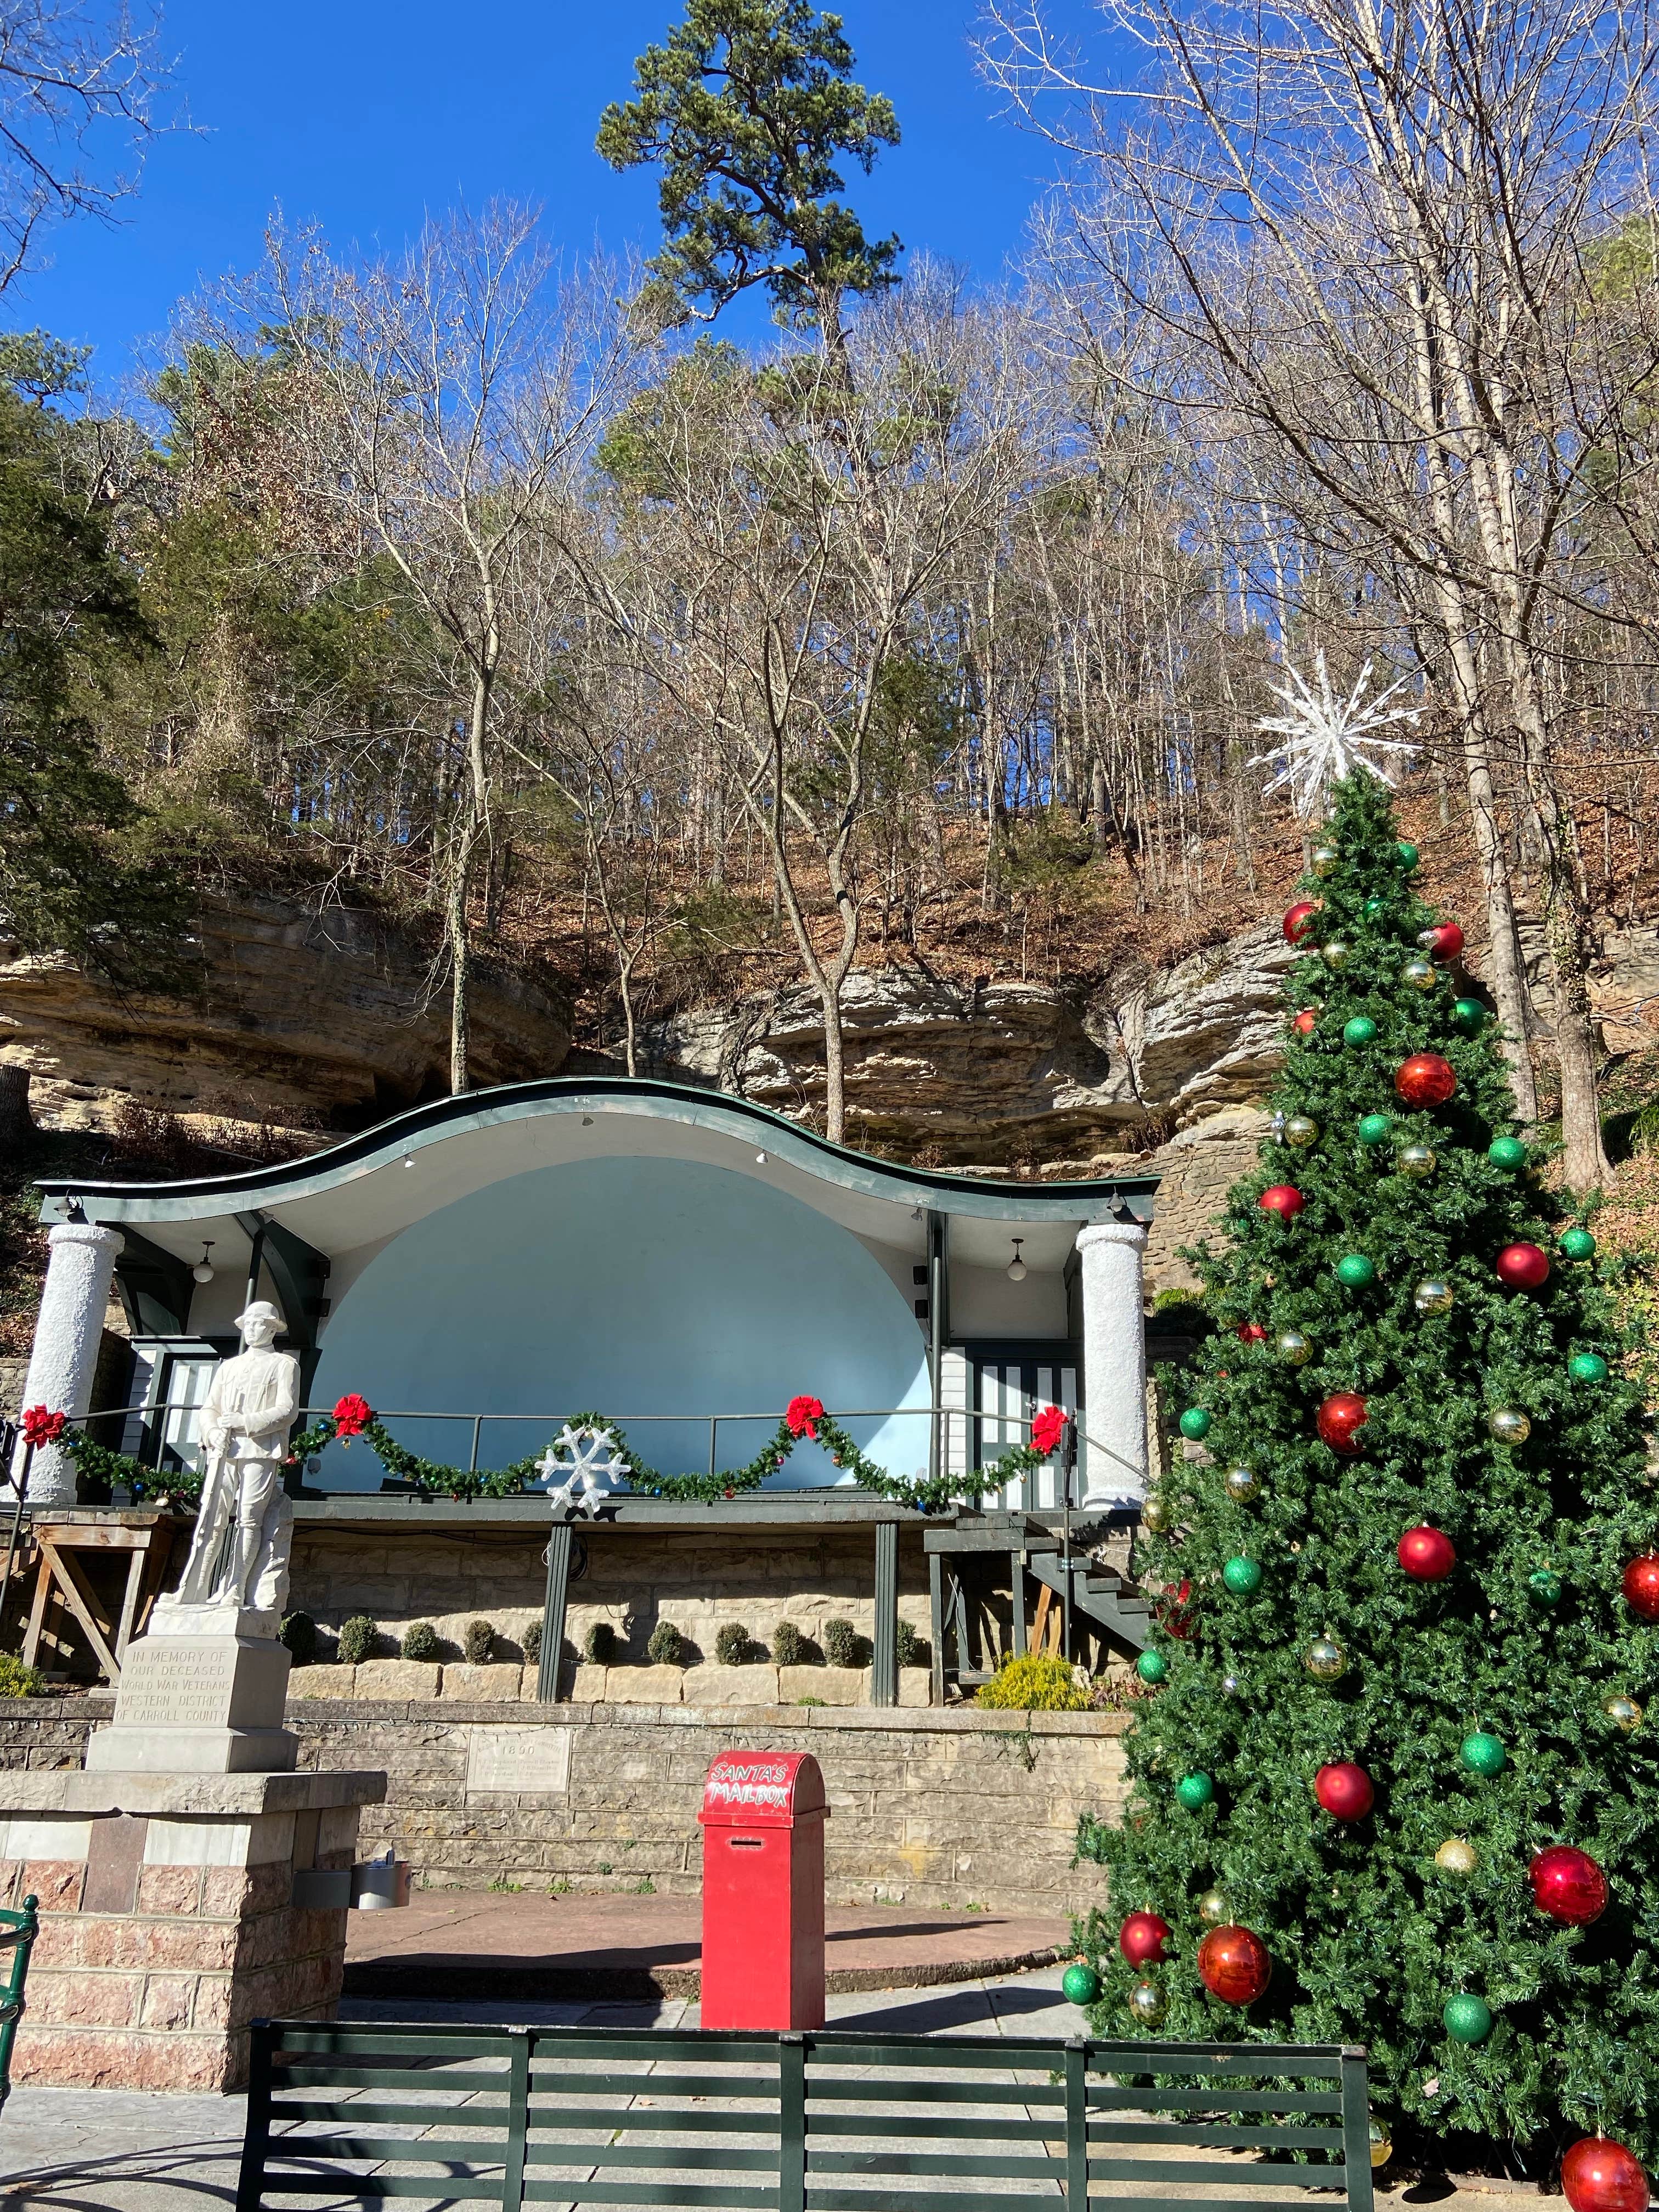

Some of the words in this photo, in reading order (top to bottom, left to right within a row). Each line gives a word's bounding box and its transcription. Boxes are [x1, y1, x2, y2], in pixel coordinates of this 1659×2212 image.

[132, 1651, 145, 1662] IN
[150, 1651, 205, 1662] MEMORY
[211, 1651, 228, 1662] OF
[131, 1666, 154, 1675] OUR
[161, 1666, 225, 1675] DECEASED
[121, 1679, 153, 1690] WORLD
[157, 1679, 178, 1690] WAR
[183, 1679, 230, 1690] VETERANS
[121, 1695, 170, 1706] WESTERN
[179, 1695, 227, 1706] DISTRICT
[116, 1710, 129, 1721] OF
[133, 1710, 180, 1721] CARROLL
[186, 1710, 227, 1721] COUNTY
[502, 1746, 535, 1755] 1890
[711, 1762, 788, 1782] SANTA'S
[709, 1782, 788, 1808] MAILBOX
